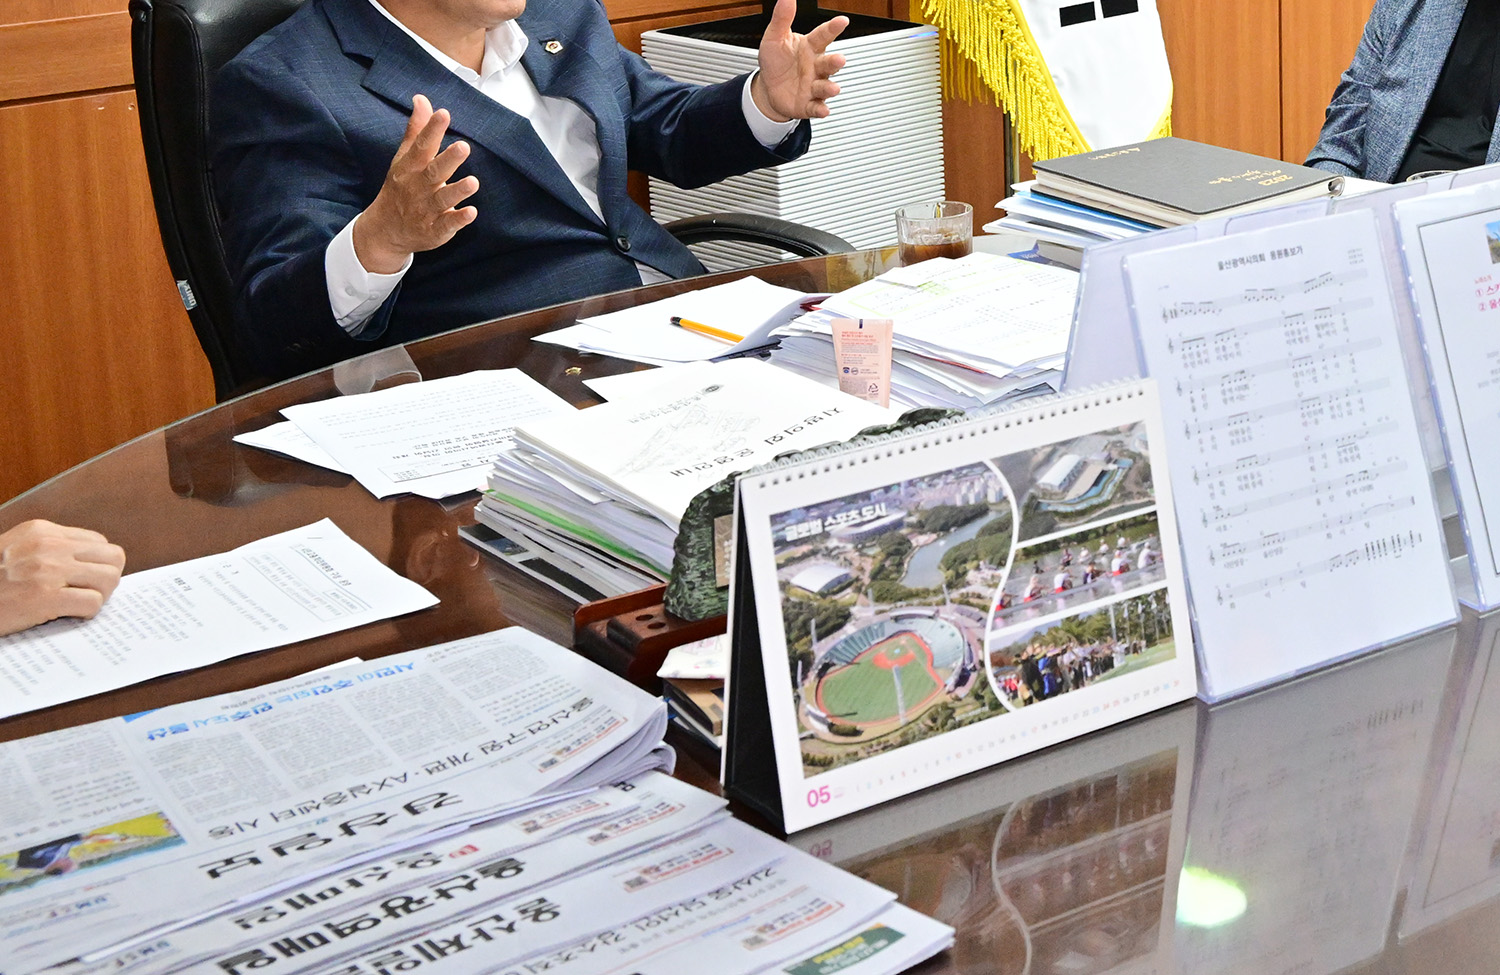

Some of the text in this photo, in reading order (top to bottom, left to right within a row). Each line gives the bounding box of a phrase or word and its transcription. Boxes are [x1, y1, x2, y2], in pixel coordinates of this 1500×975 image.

[670, 407, 844, 478] 지방의회 운영안내
[861, 502, 887, 522] 도시
[274, 678, 355, 705] 주인되는
[356, 662, 416, 683] 시민이
[192, 703, 273, 729] 민주도시
[478, 696, 594, 756] 울산연구원
[806, 784, 831, 809] 05
[198, 792, 464, 881] 경상일보
[208, 818, 260, 841] 시동
[229, 852, 444, 932] 울산매일
[216, 857, 527, 975] 울산광역매일
[325, 898, 561, 975] 울산제일
